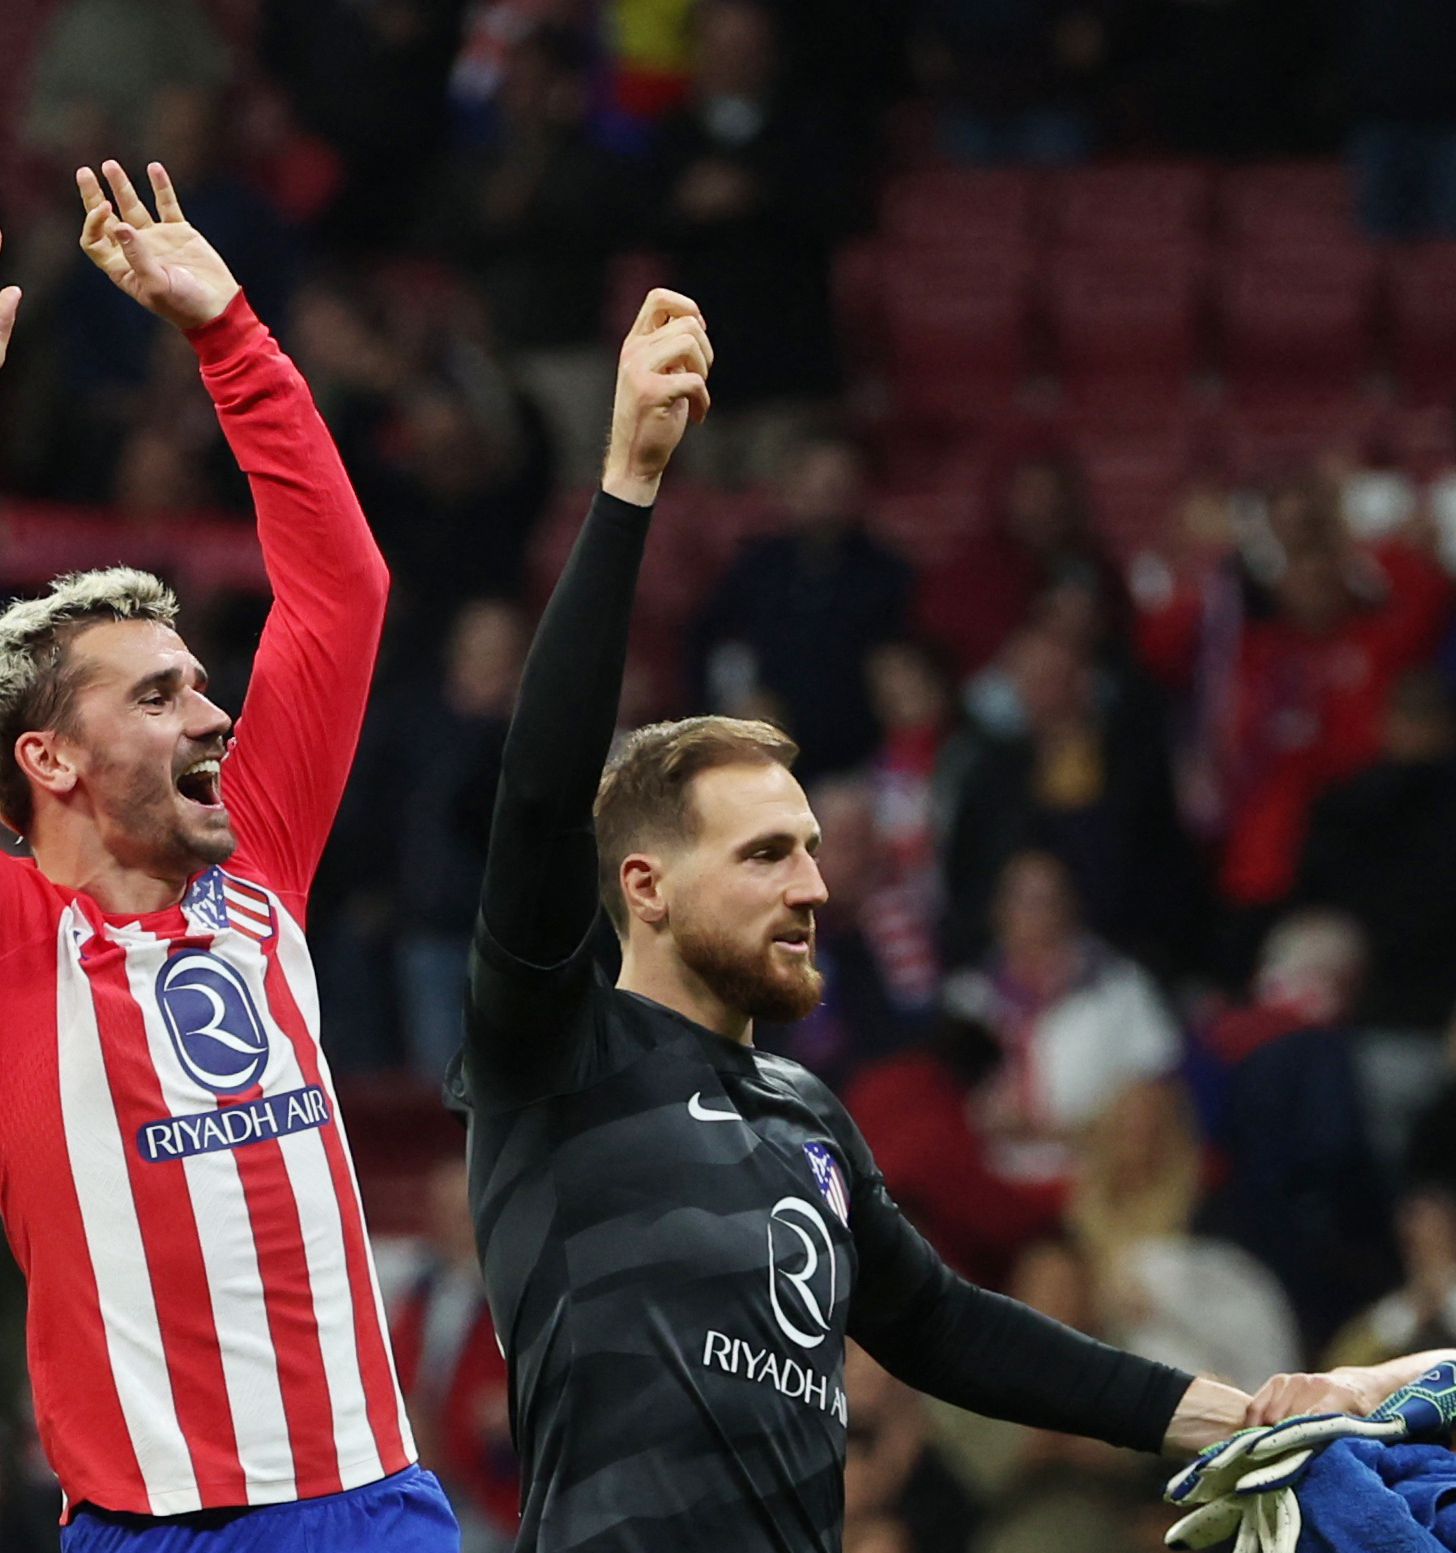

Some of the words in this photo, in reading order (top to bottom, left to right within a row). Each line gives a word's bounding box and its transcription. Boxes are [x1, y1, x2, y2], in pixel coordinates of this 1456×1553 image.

[145, 1102, 278, 1159] RIYADH
[287, 1089, 329, 1130] AIR
[702, 1330, 827, 1411] RIYADH
